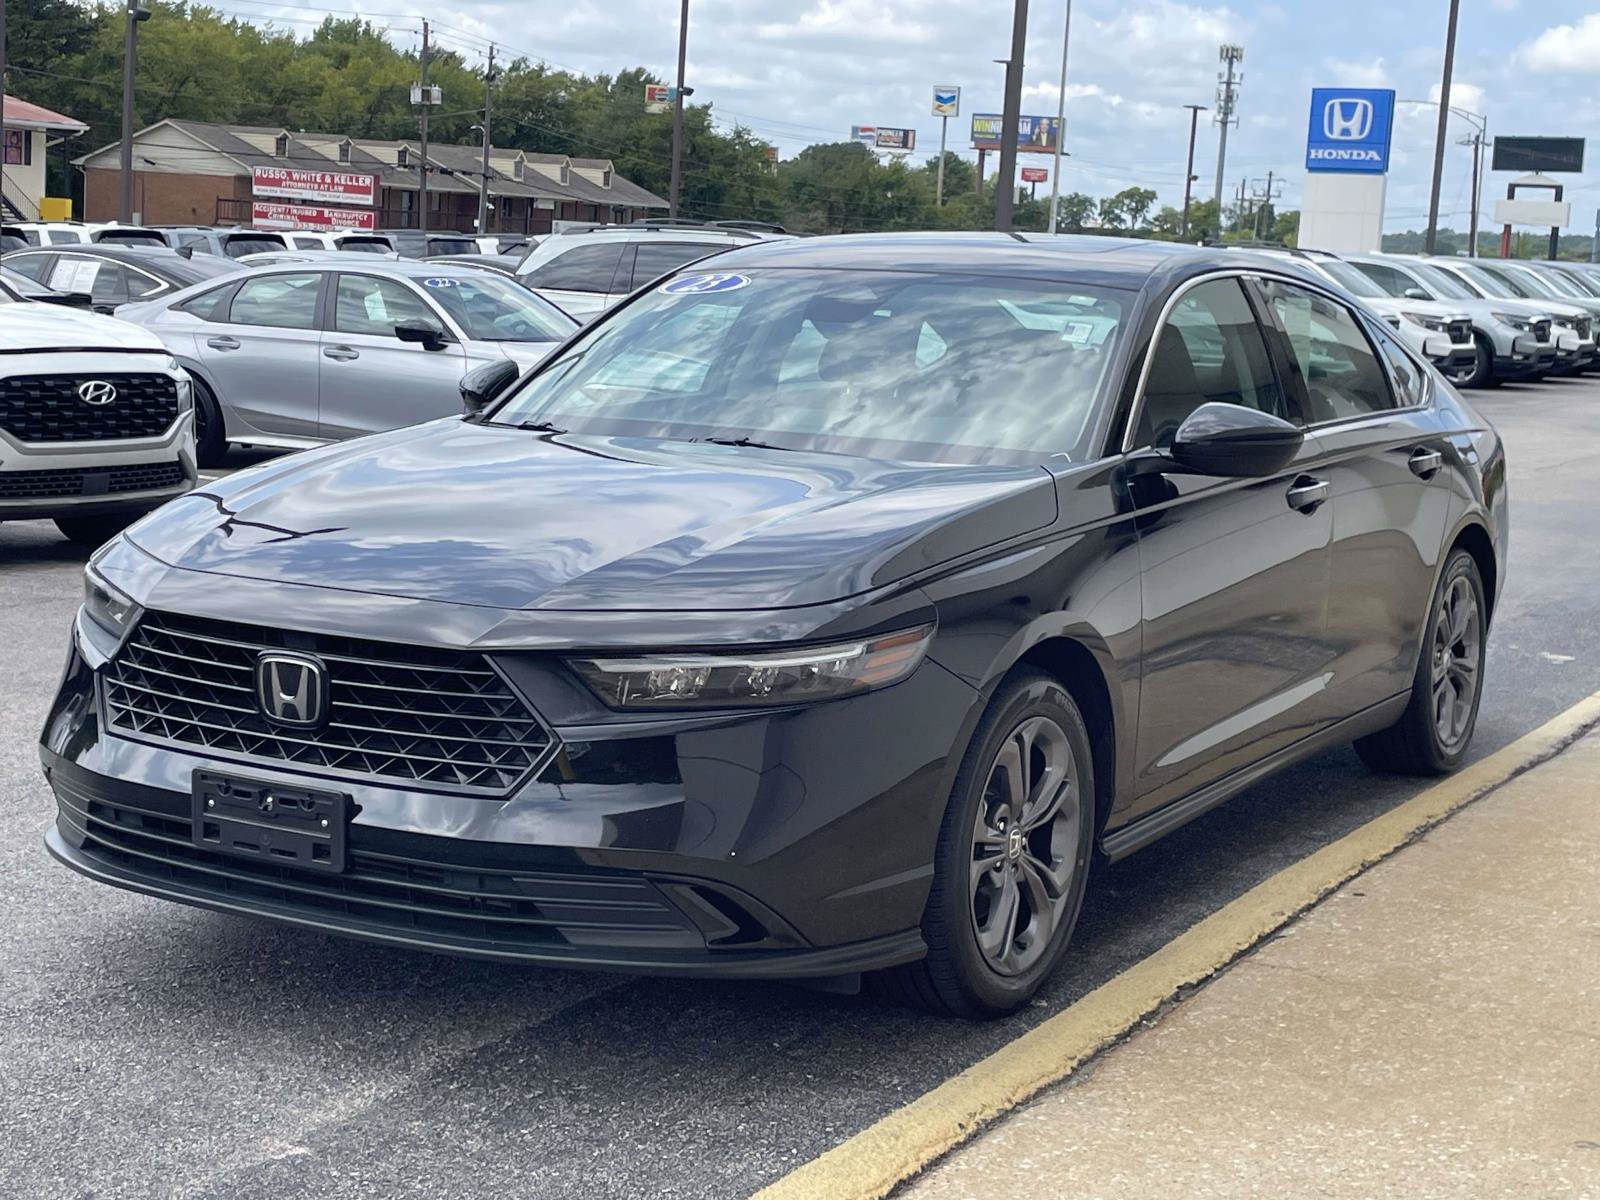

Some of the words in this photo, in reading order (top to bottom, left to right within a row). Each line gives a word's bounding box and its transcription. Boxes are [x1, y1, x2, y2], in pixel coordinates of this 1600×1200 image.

[1310, 149, 1381, 161] HONDA
[255, 168, 290, 180] RUSSO,
[292, 171, 322, 183] WHITE
[325, 174, 332, 183] &
[334, 175, 371, 187] KELLER
[281, 180, 319, 190] ATTORNEYS
[320, 183, 328, 191] AT
[329, 184, 345, 192] LAW
